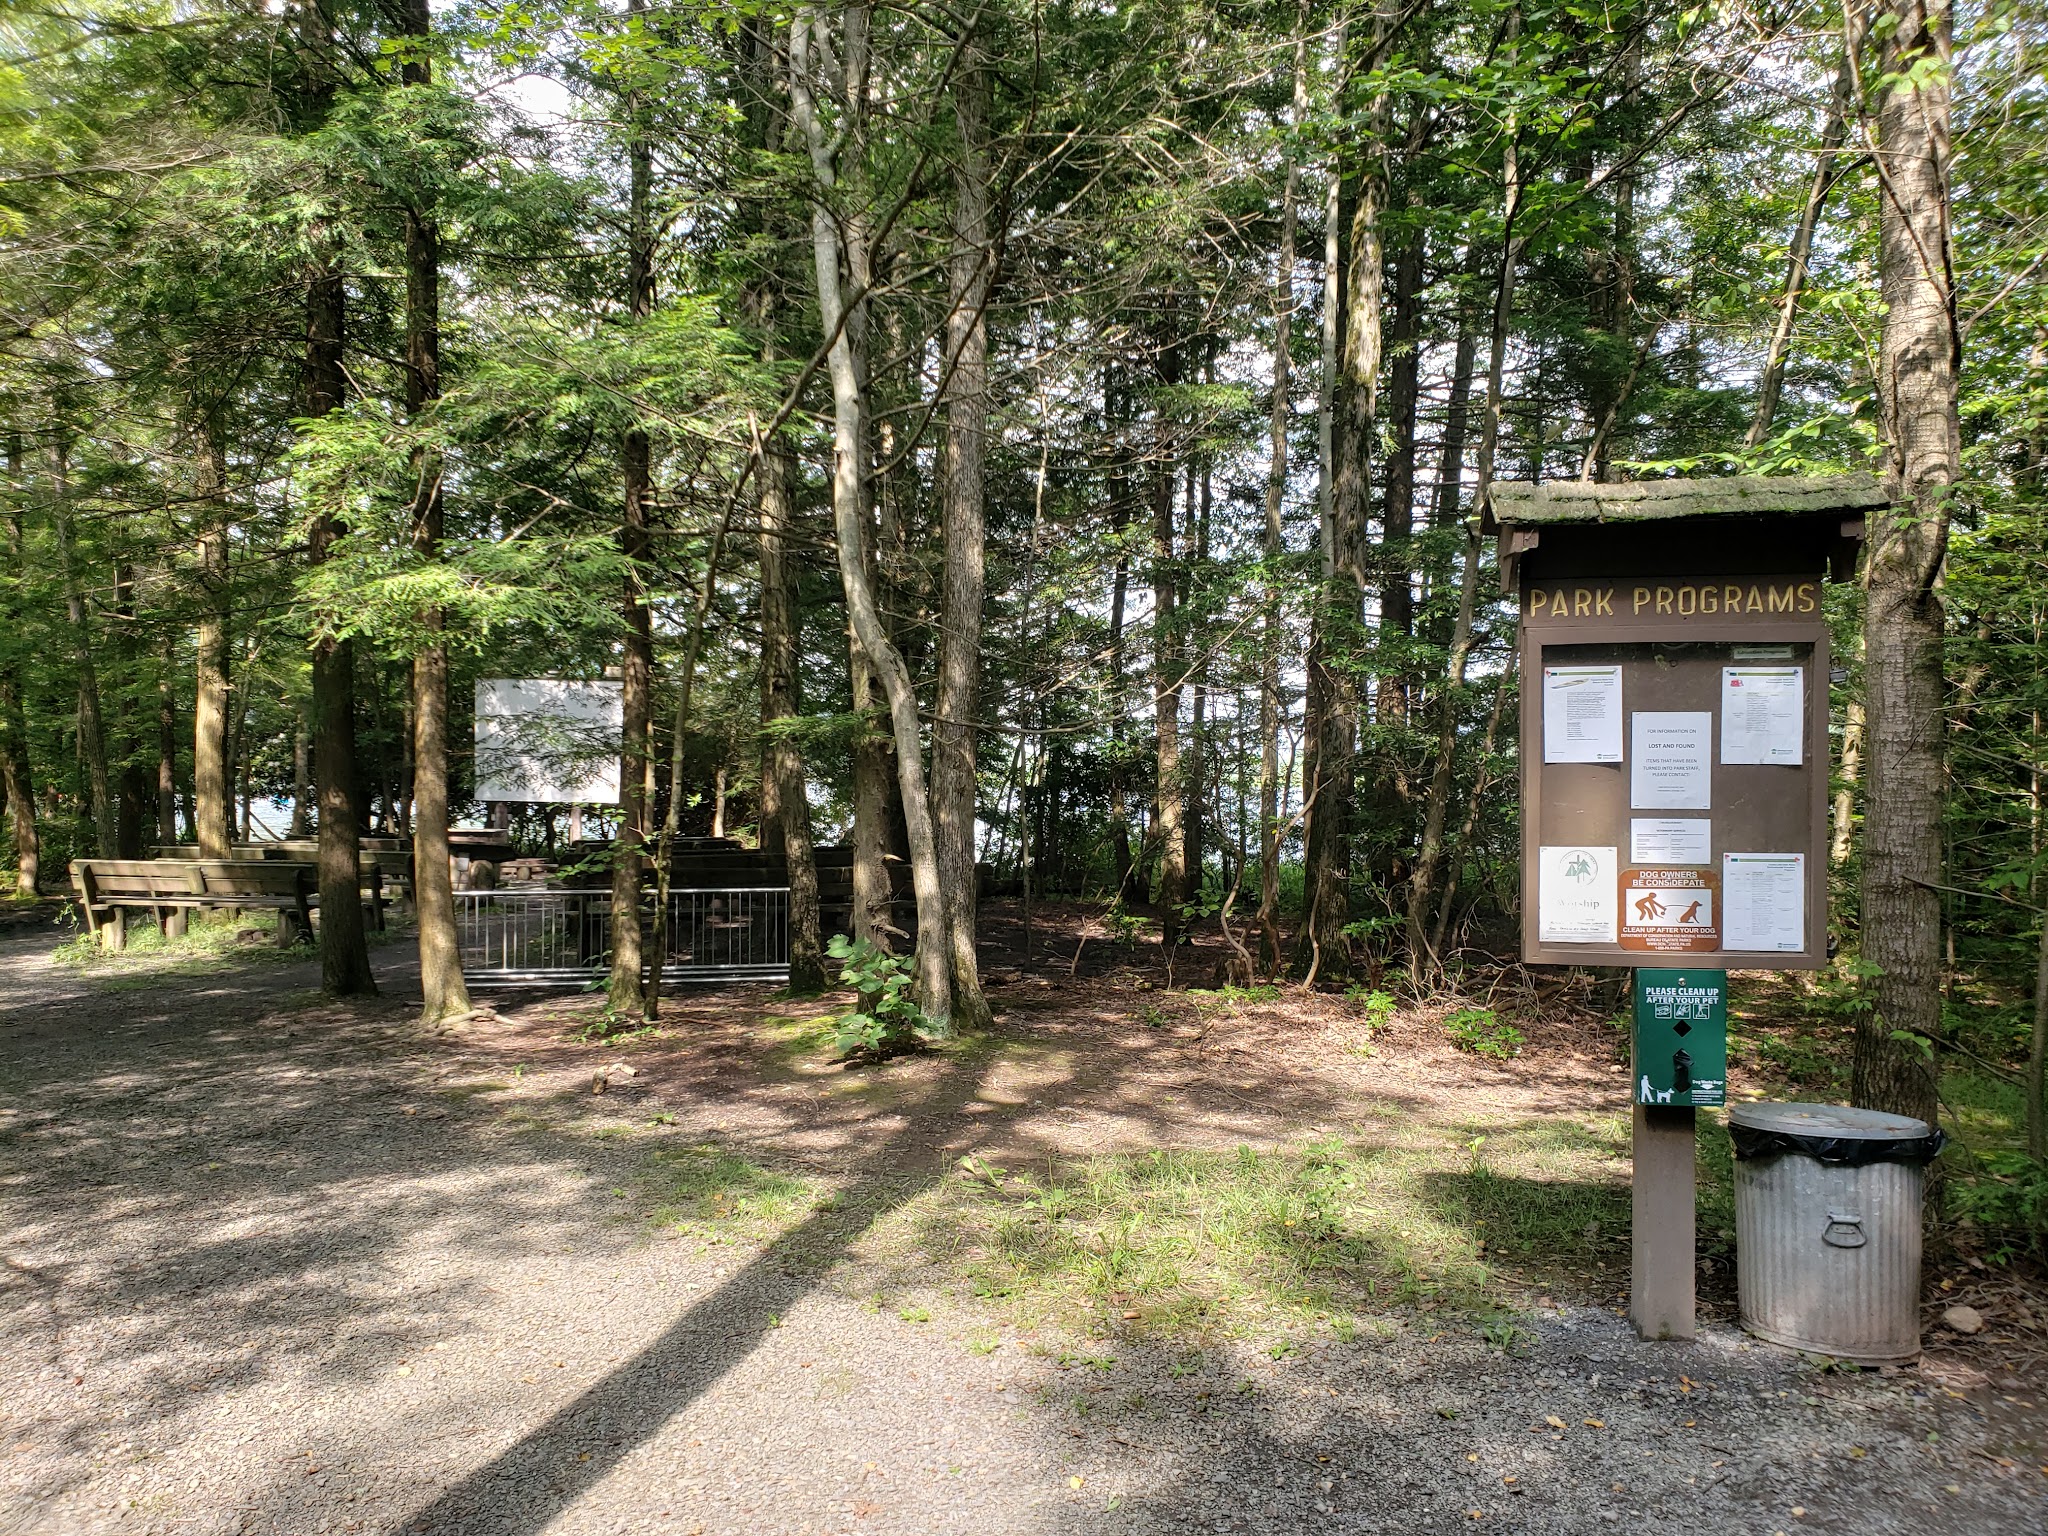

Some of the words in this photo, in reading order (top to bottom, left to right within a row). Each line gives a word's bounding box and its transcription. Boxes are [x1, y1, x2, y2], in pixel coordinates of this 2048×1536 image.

[1530, 588, 1614, 618] PARK
[1632, 583, 1815, 616] PROGRAMS
[1639, 870, 1659, 878] DOG
[1660, 870, 1698, 878] OWNERS
[1645, 987, 1677, 995] PLEASE
[1678, 987, 1705, 996] CLEAN
[1707, 988, 1719, 996] UP
[1646, 996, 1674, 1004] AFTER
